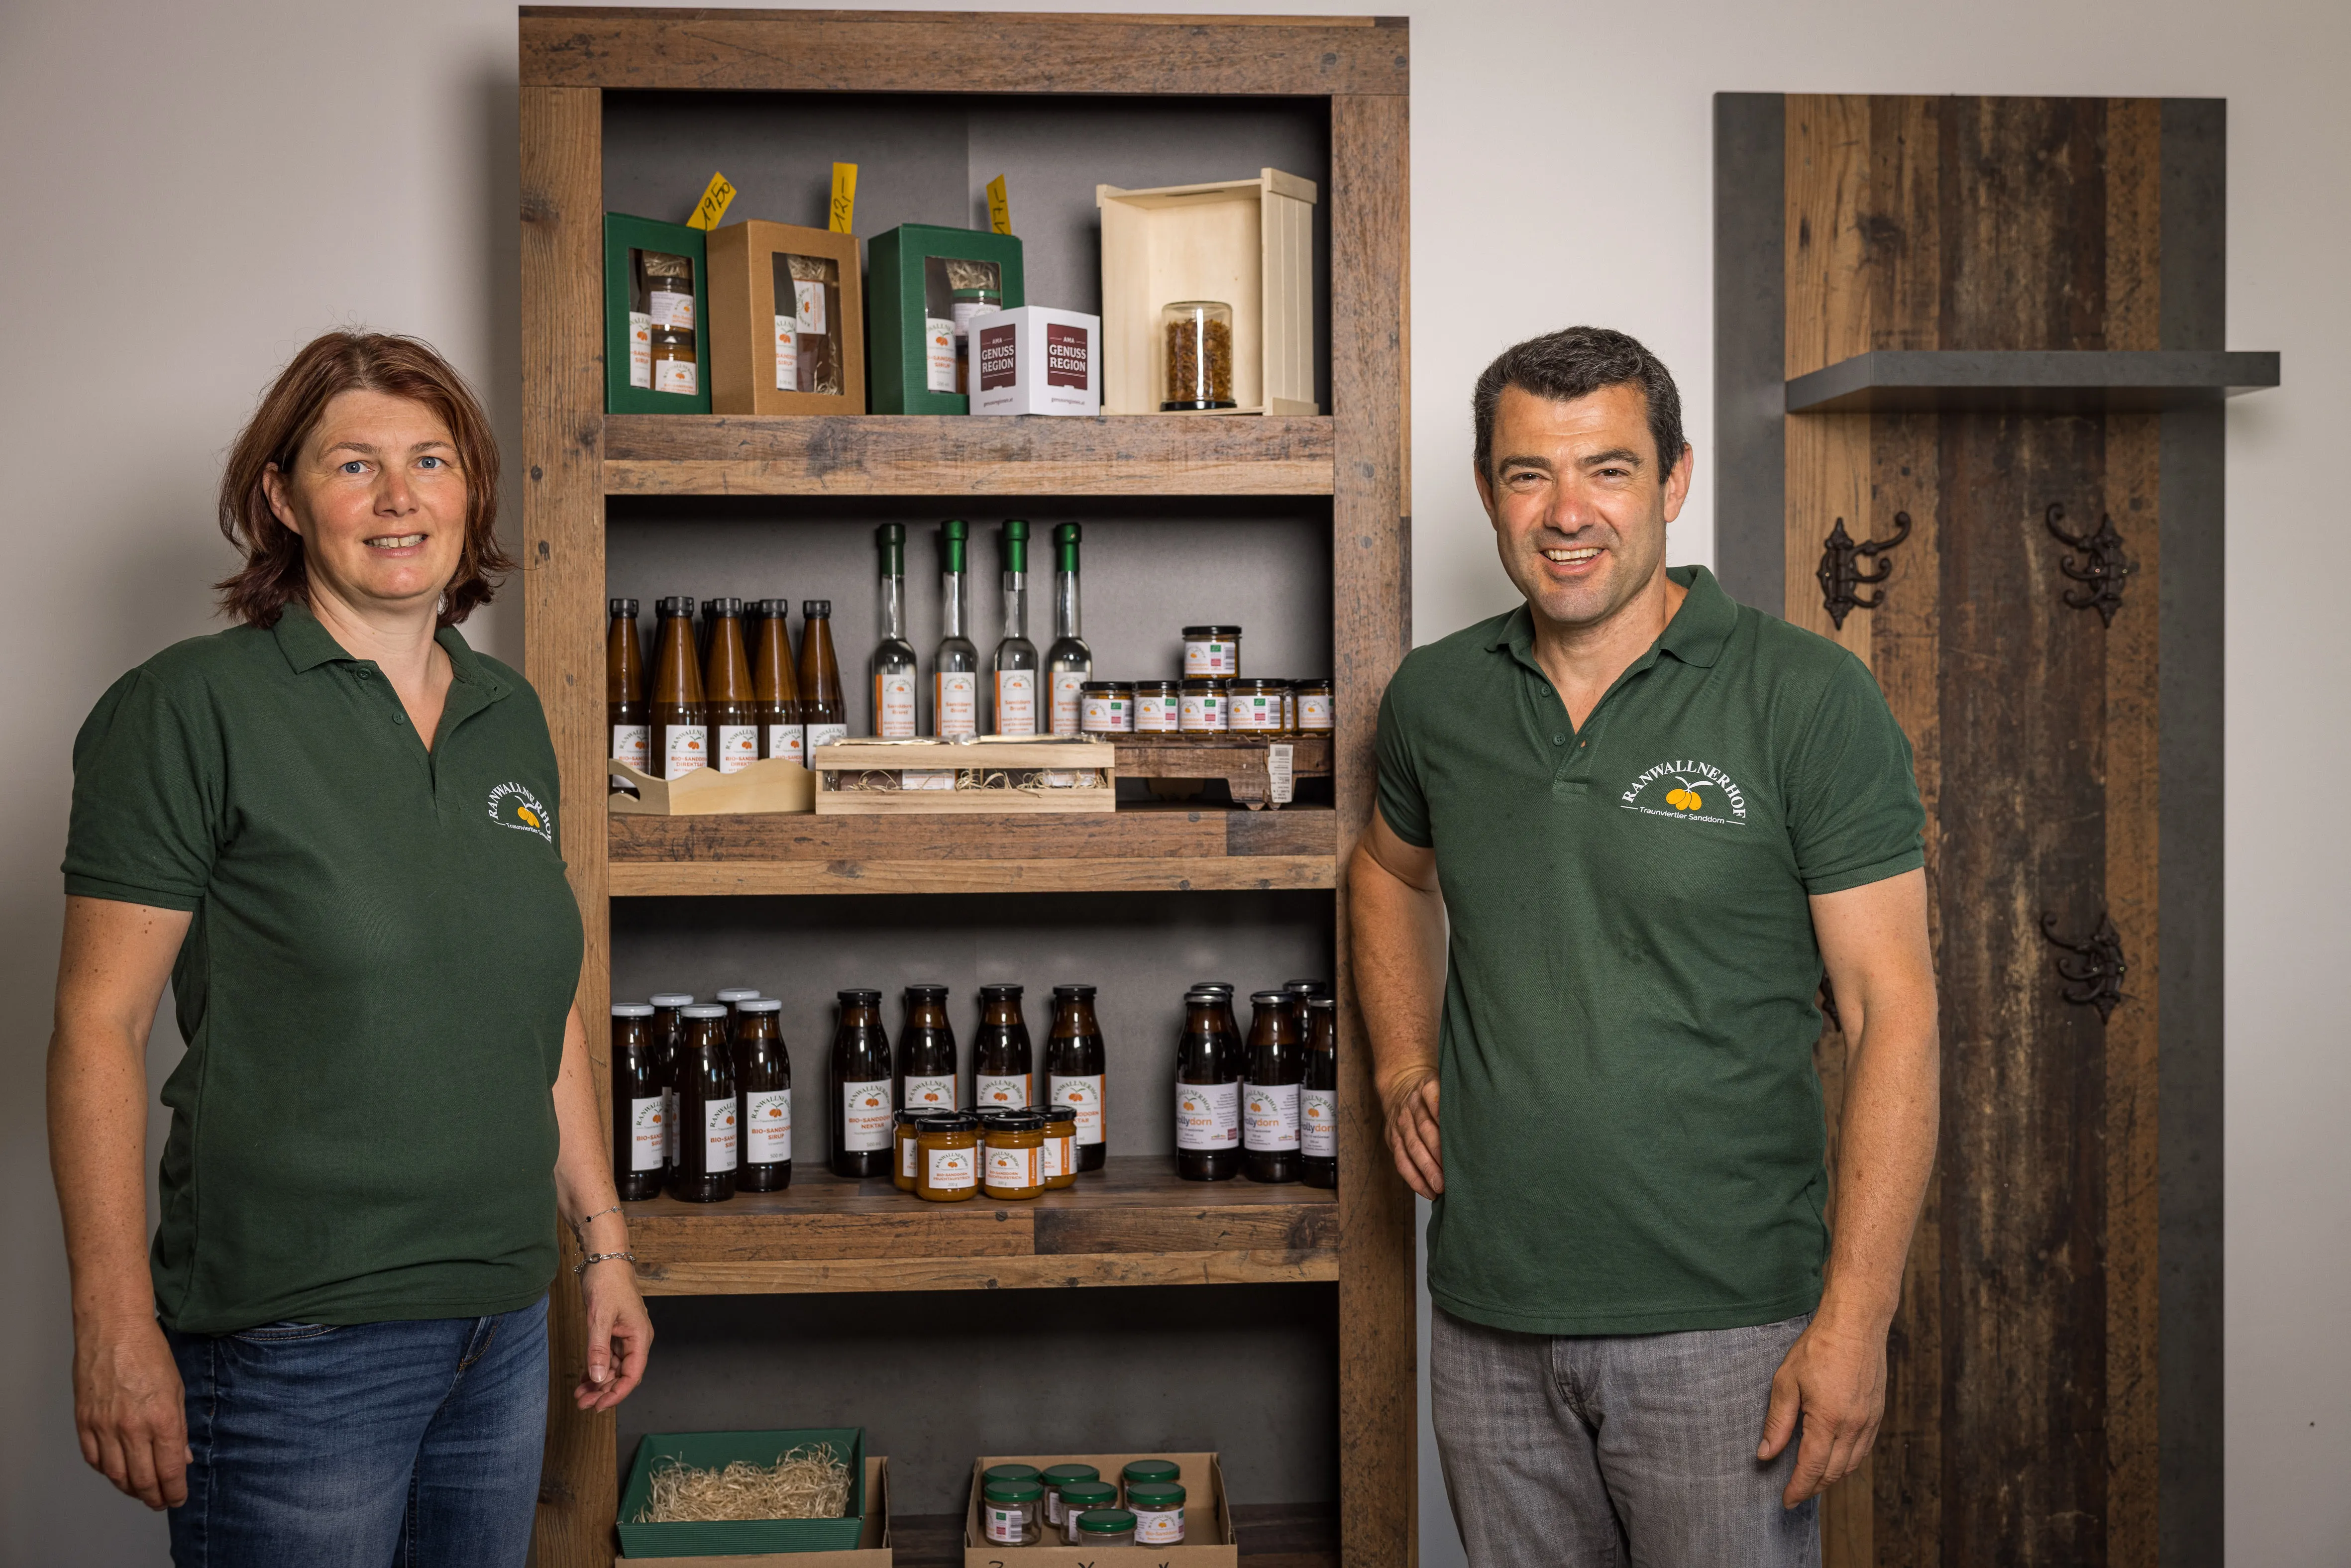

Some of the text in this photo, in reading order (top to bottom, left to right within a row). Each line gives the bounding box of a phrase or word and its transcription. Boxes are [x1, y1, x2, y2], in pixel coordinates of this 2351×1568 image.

[981, 344, 1014, 361] GENUSS
[1049, 344, 1086, 360] GENUSS
[982, 357, 1014, 373] REGION
[1050, 356, 1086, 372] REGION
[1622, 760, 1746, 819] RANWALLNERHOF
[1639, 806, 1725, 824] Traunviertler Sanddorn
[505, 823, 538, 834] Traunviertler
